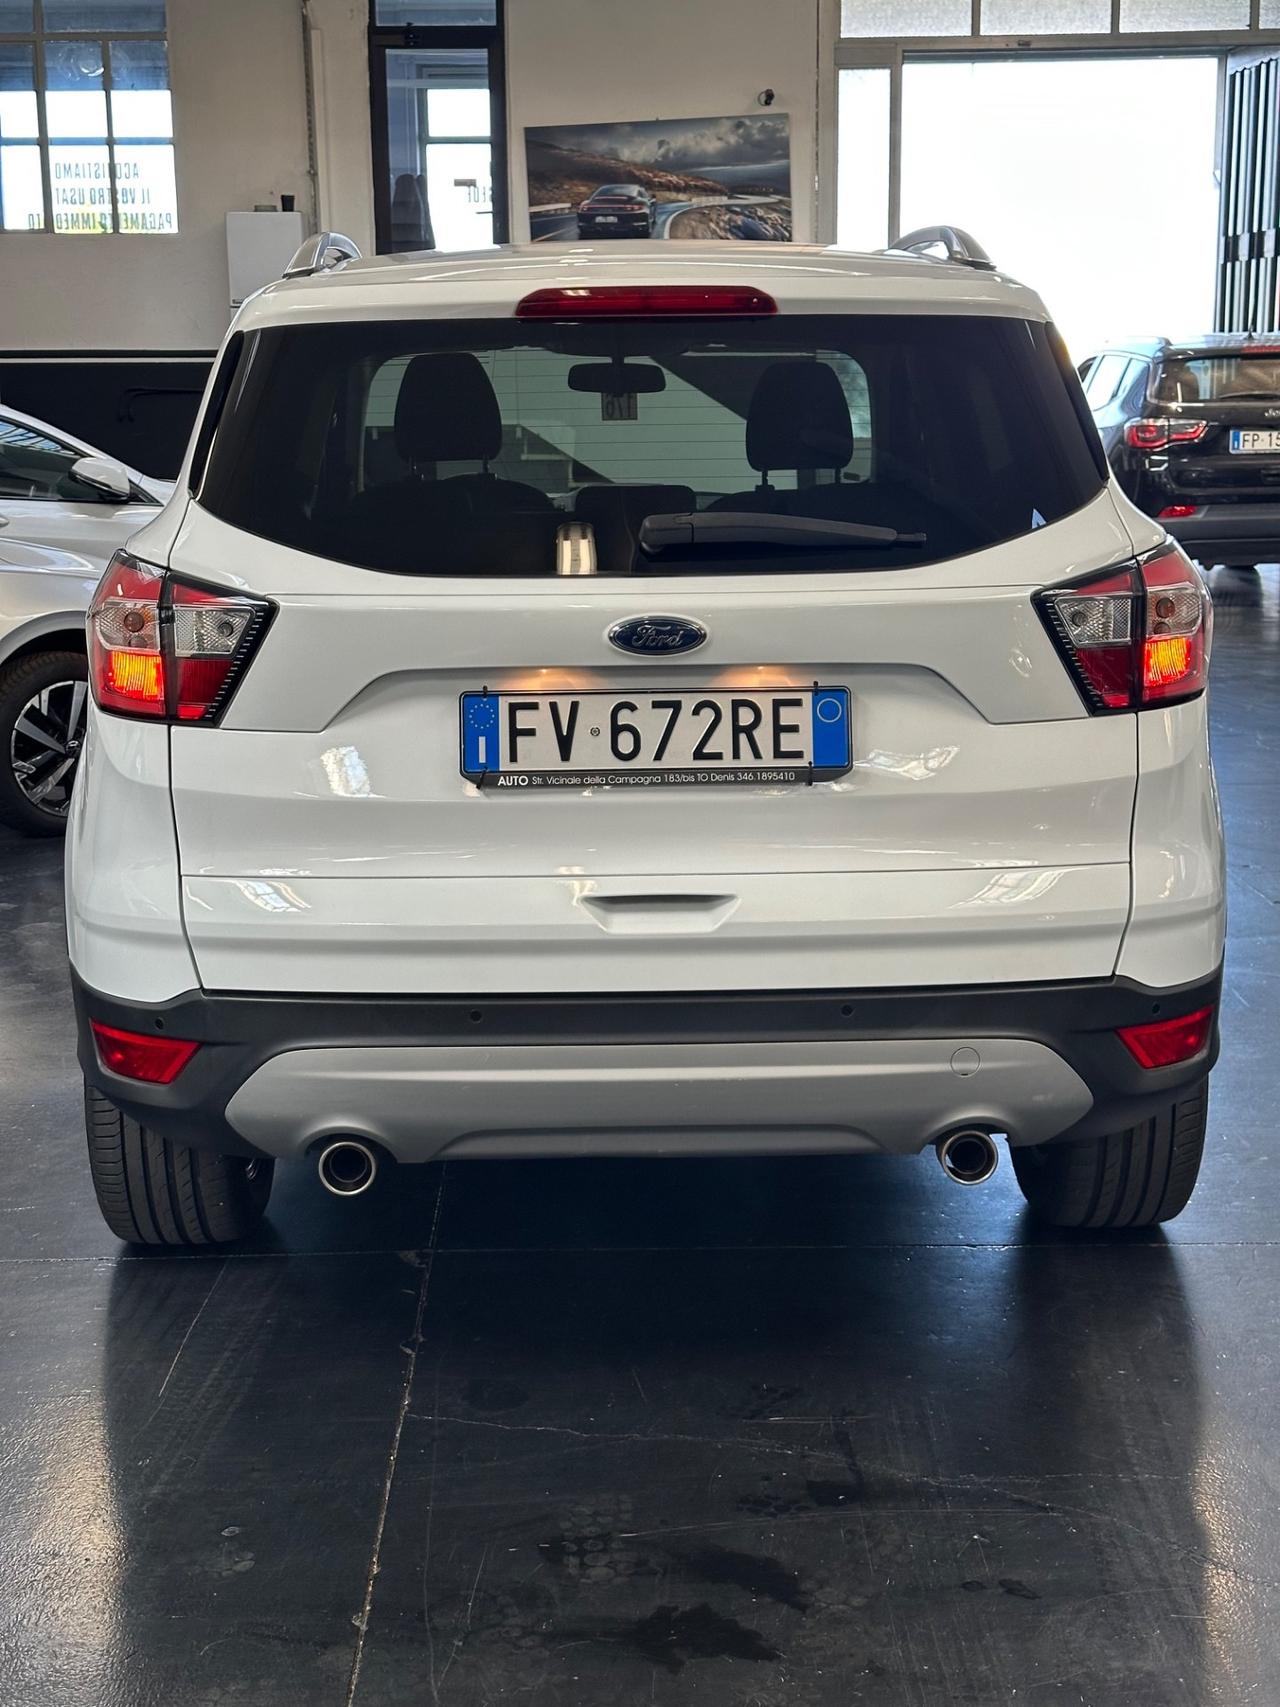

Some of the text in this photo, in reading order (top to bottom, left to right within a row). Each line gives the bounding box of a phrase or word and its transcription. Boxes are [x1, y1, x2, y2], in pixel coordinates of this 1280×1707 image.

[1242, 433, 1260, 448] FP
[631, 624, 685, 648] Ford
[508, 697, 805, 763] FV 672RE
[497, 775, 529, 786] AUTO
[532, 776, 544, 785] Str.
[546, 775, 581, 785] Vicinale
[583, 775, 606, 785] della
[608, 774, 661, 785] Campagna
[664, 773, 696, 783] 183/bis
[710, 773, 735, 782] Denis
[737, 771, 796, 782] 346.1895410
